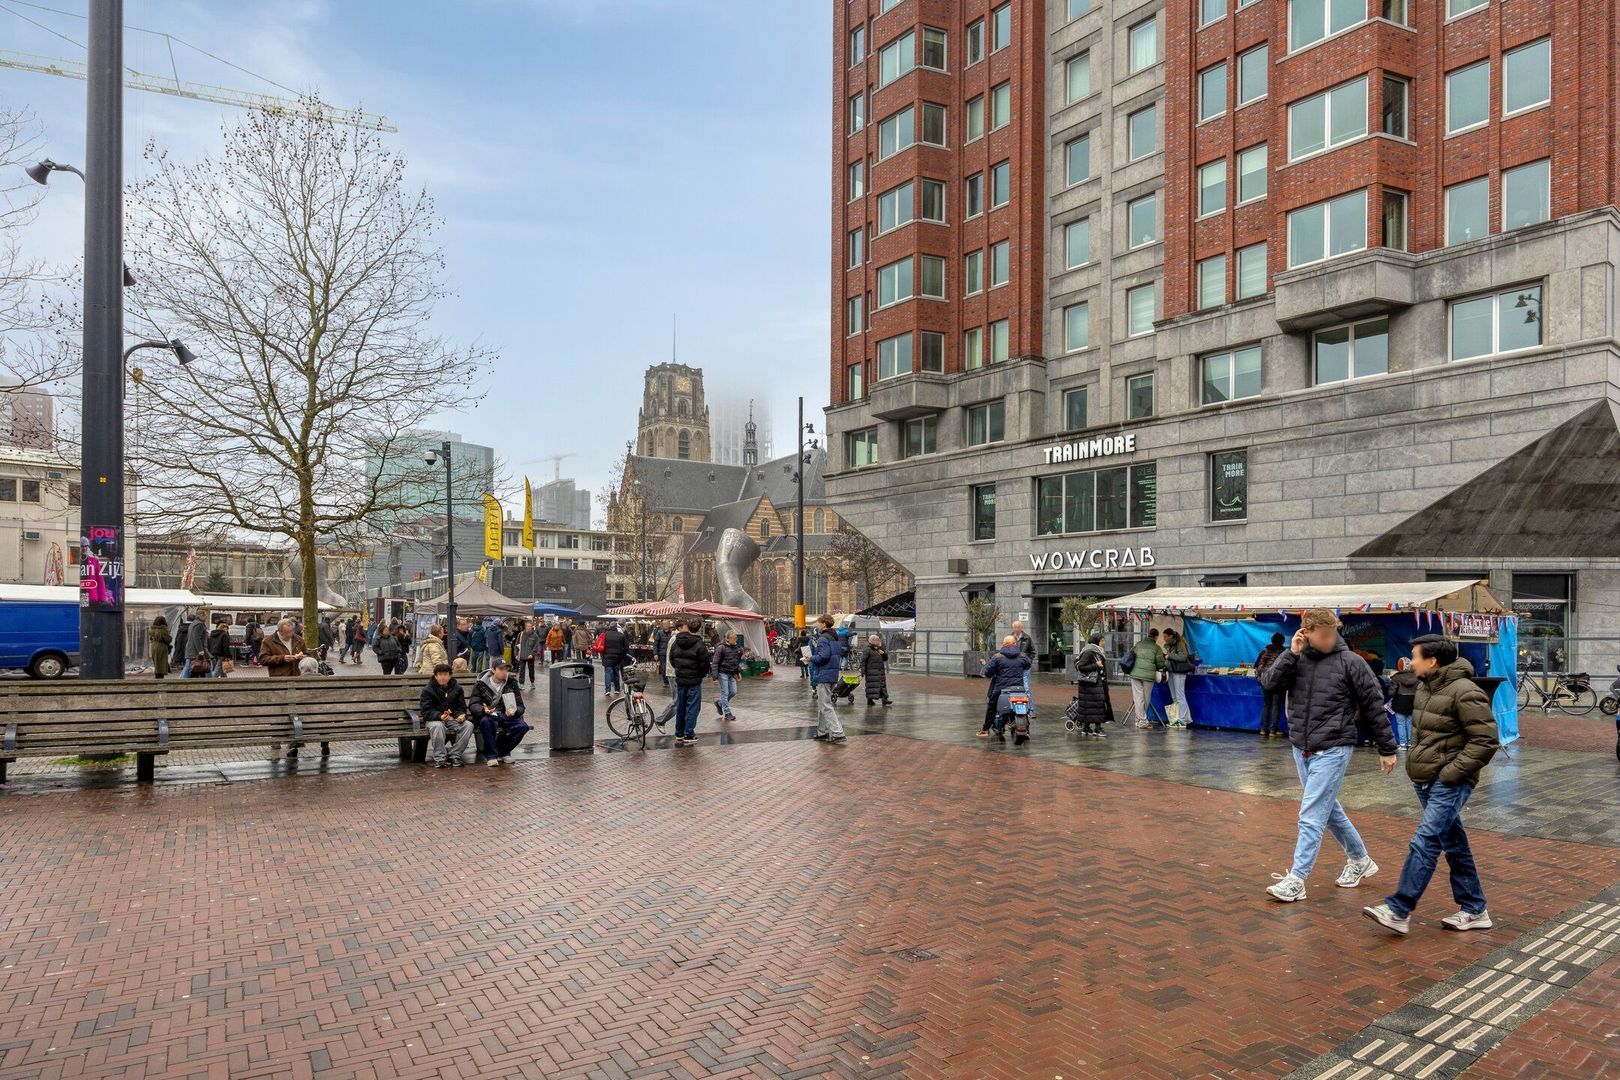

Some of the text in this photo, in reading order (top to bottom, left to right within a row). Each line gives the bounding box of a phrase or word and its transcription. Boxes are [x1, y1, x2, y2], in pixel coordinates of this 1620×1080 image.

[1043, 433, 1136, 464] TRAINMORE
[1222, 462, 1243, 471] TRAIN
[1225, 469, 1245, 478] MORE
[89, 526, 116, 541] jou
[1029, 546, 1156, 570] WOWCRAB
[1513, 602, 1559, 611] Seafood Bar
